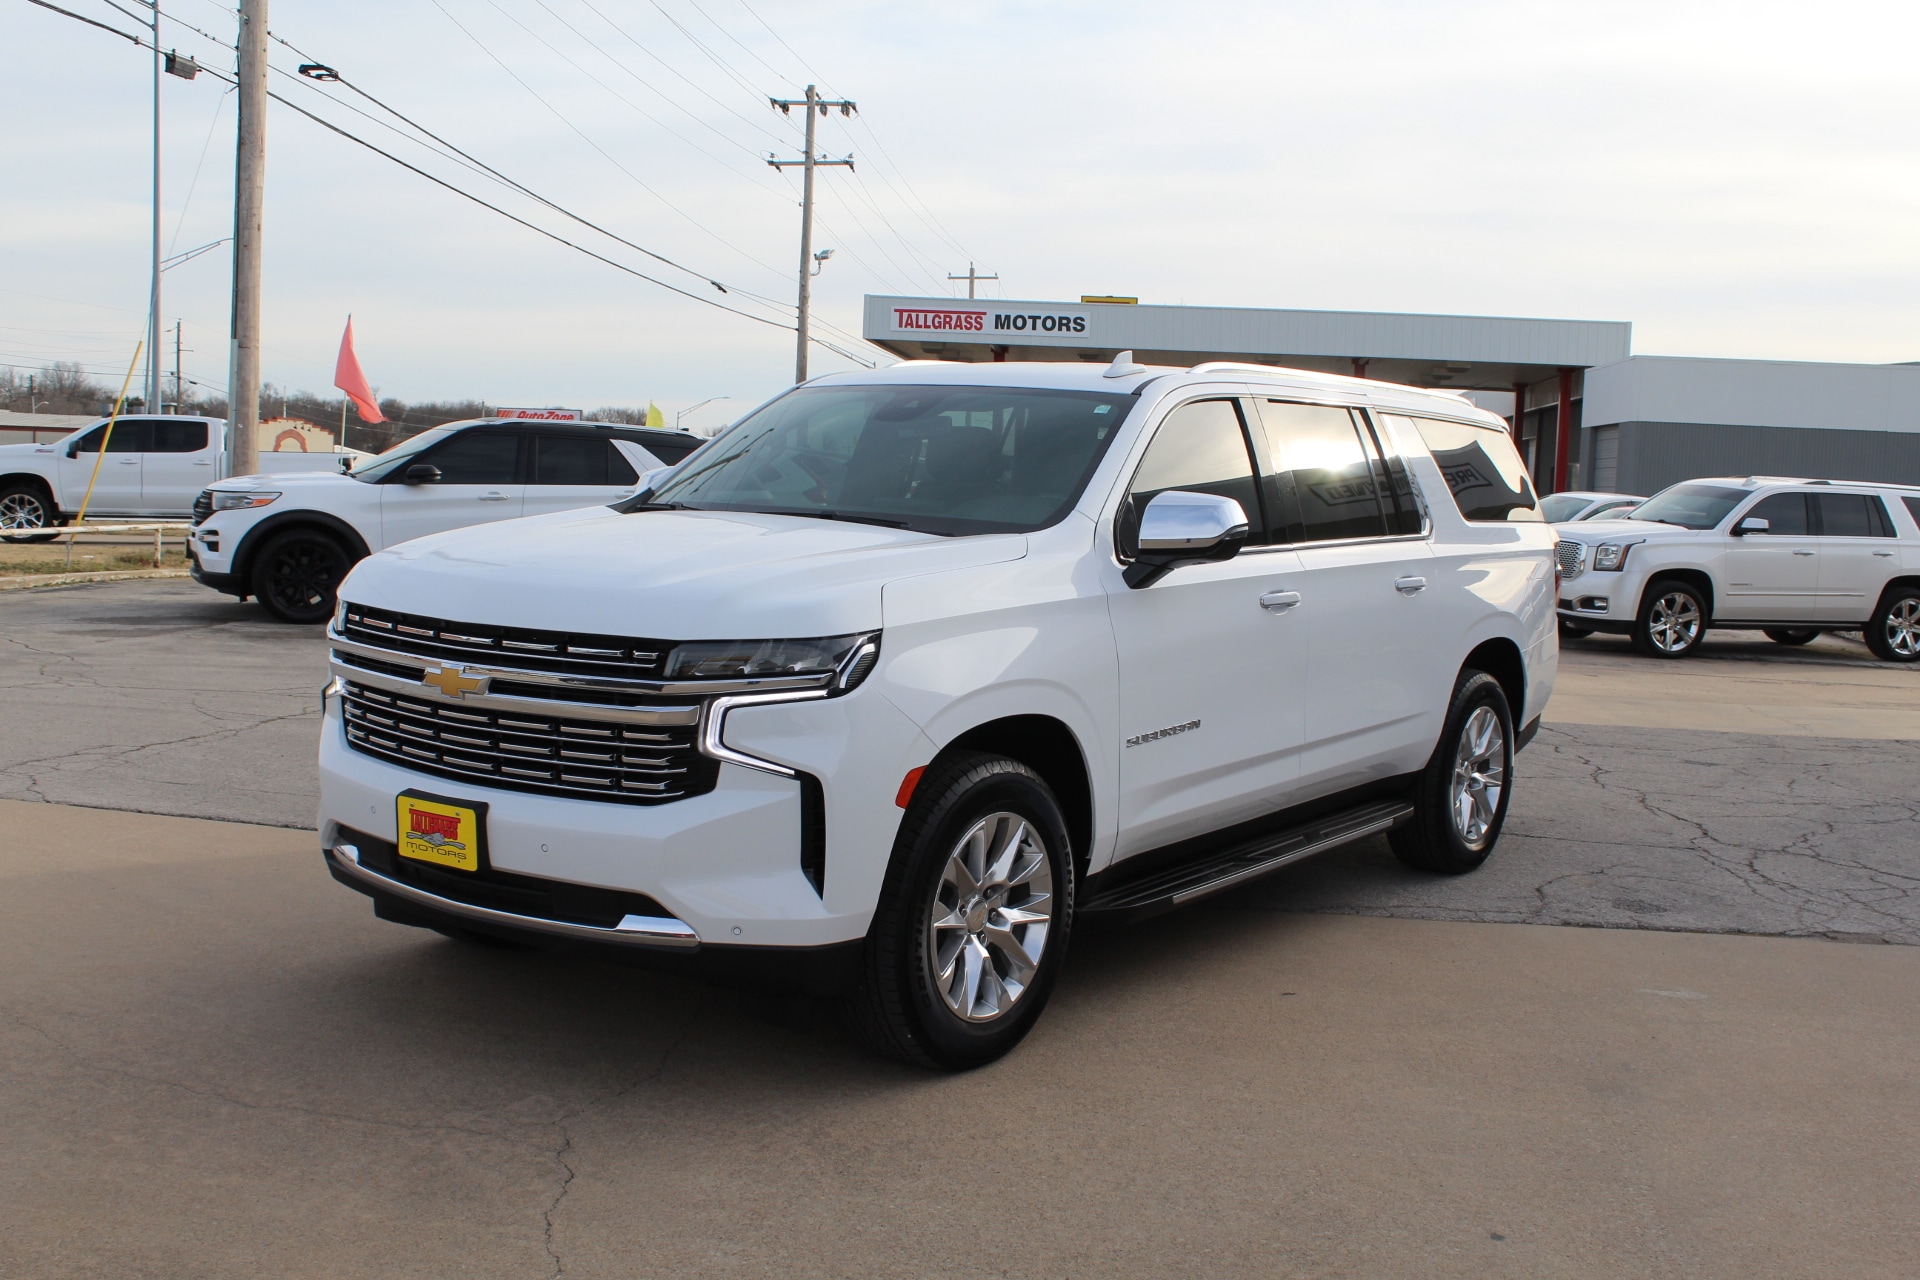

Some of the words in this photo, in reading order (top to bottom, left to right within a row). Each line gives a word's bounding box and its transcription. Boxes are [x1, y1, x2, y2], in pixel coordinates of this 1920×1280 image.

[894, 308, 987, 331] TALLGRASS
[994, 314, 1085, 332] MOTORS
[1126, 719, 1201, 748] SUBURBAN
[406, 841, 467, 859] MOTORS
